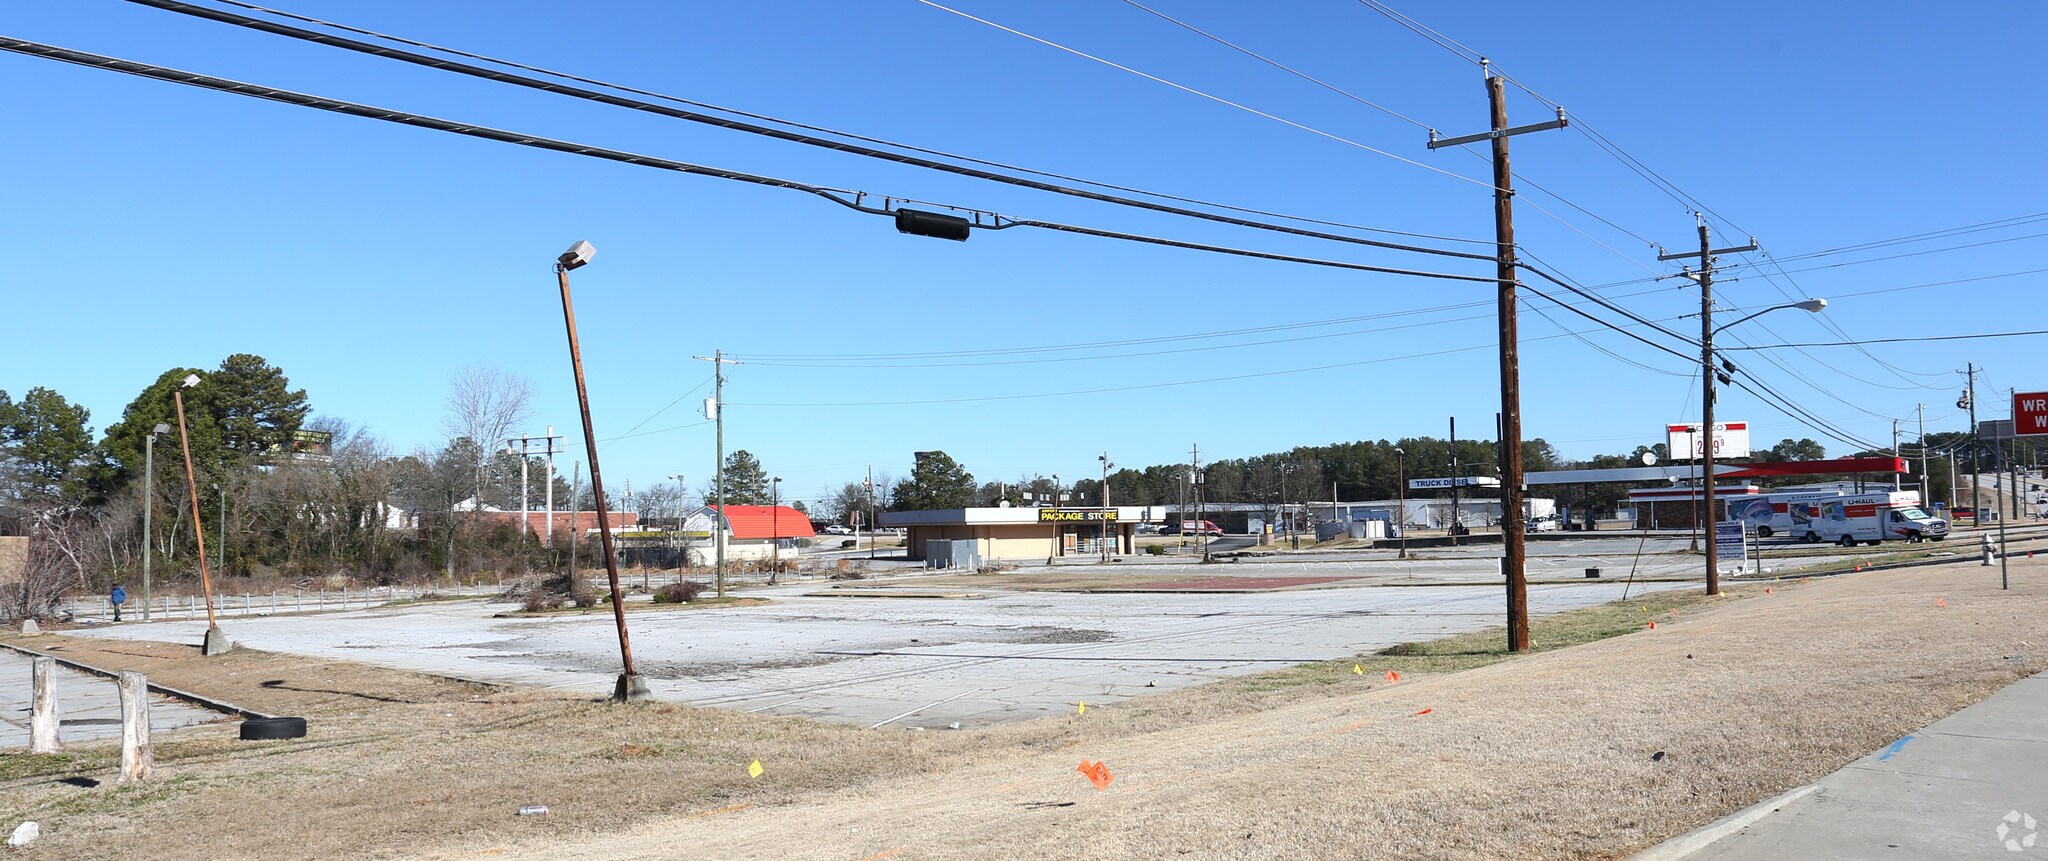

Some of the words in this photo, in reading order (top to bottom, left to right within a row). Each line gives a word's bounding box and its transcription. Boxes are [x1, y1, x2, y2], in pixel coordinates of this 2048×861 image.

[1415, 479, 1442, 487] TRUCK
[1443, 478, 1469, 486] DISEL
[1041, 512, 1084, 520] PACKAGE
[1087, 512, 1117, 520] STORE
